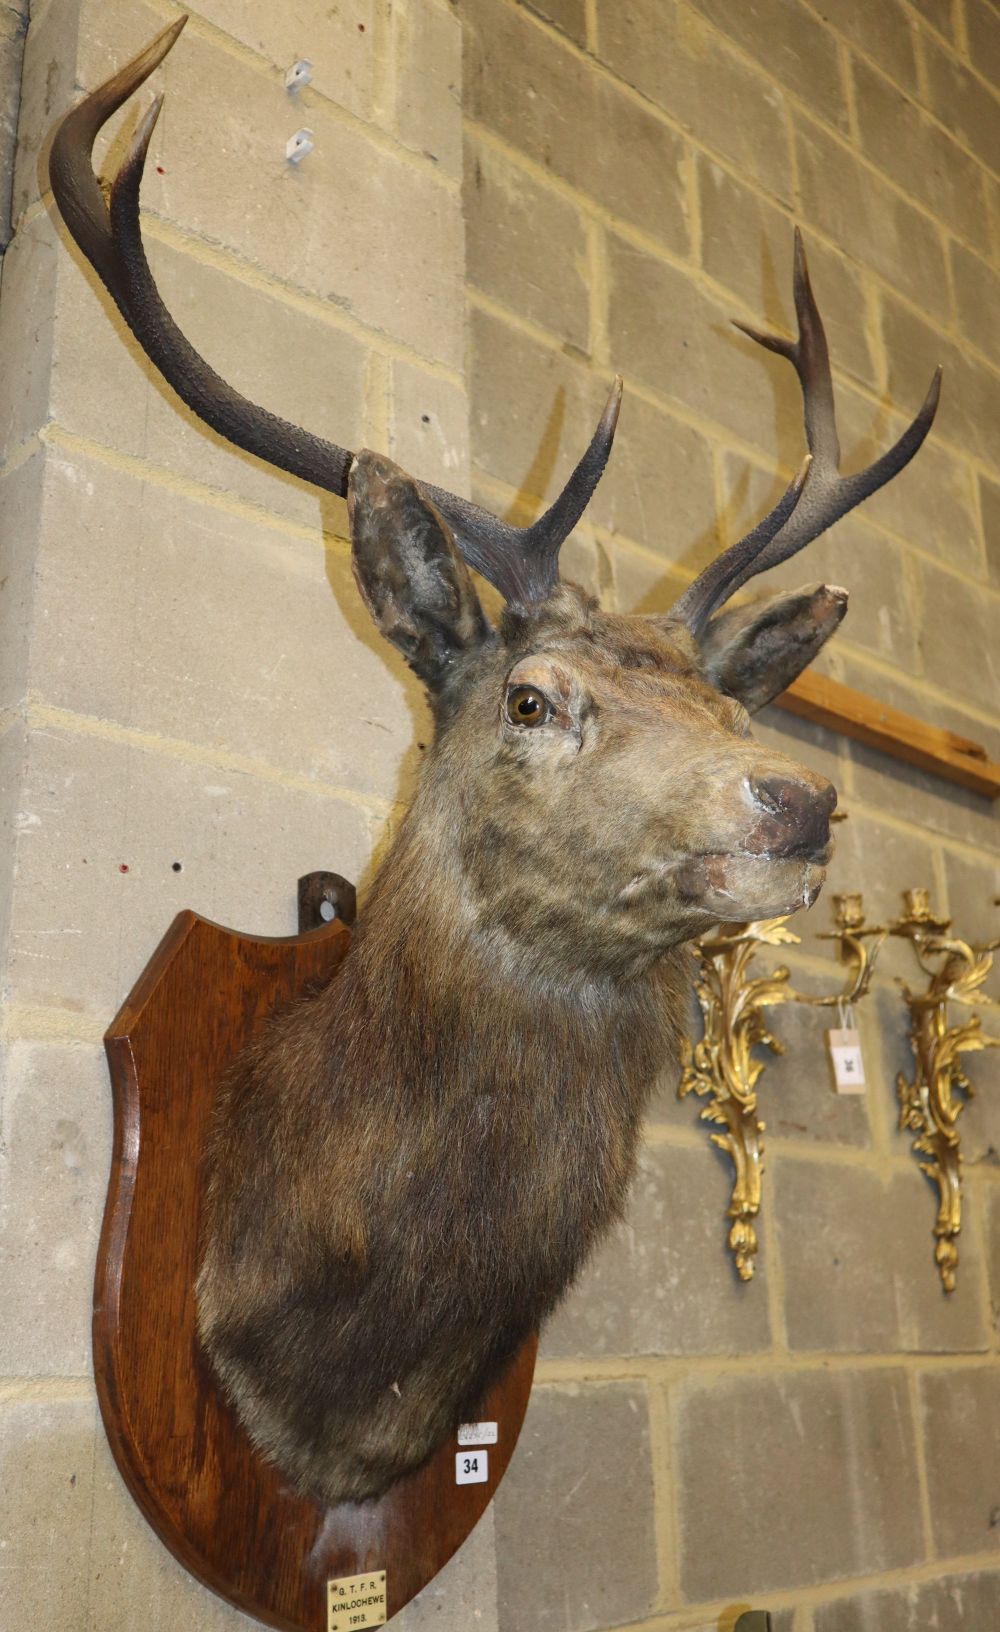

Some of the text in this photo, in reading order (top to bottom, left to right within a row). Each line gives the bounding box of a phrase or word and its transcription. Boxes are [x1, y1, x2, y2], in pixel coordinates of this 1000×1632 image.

[463, 1458, 478, 1474] 34
[349, 1585, 357, 1593] T.
[369, 1581, 376, 1589] R.
[332, 1594, 384, 1613] KINLOCHEWE
